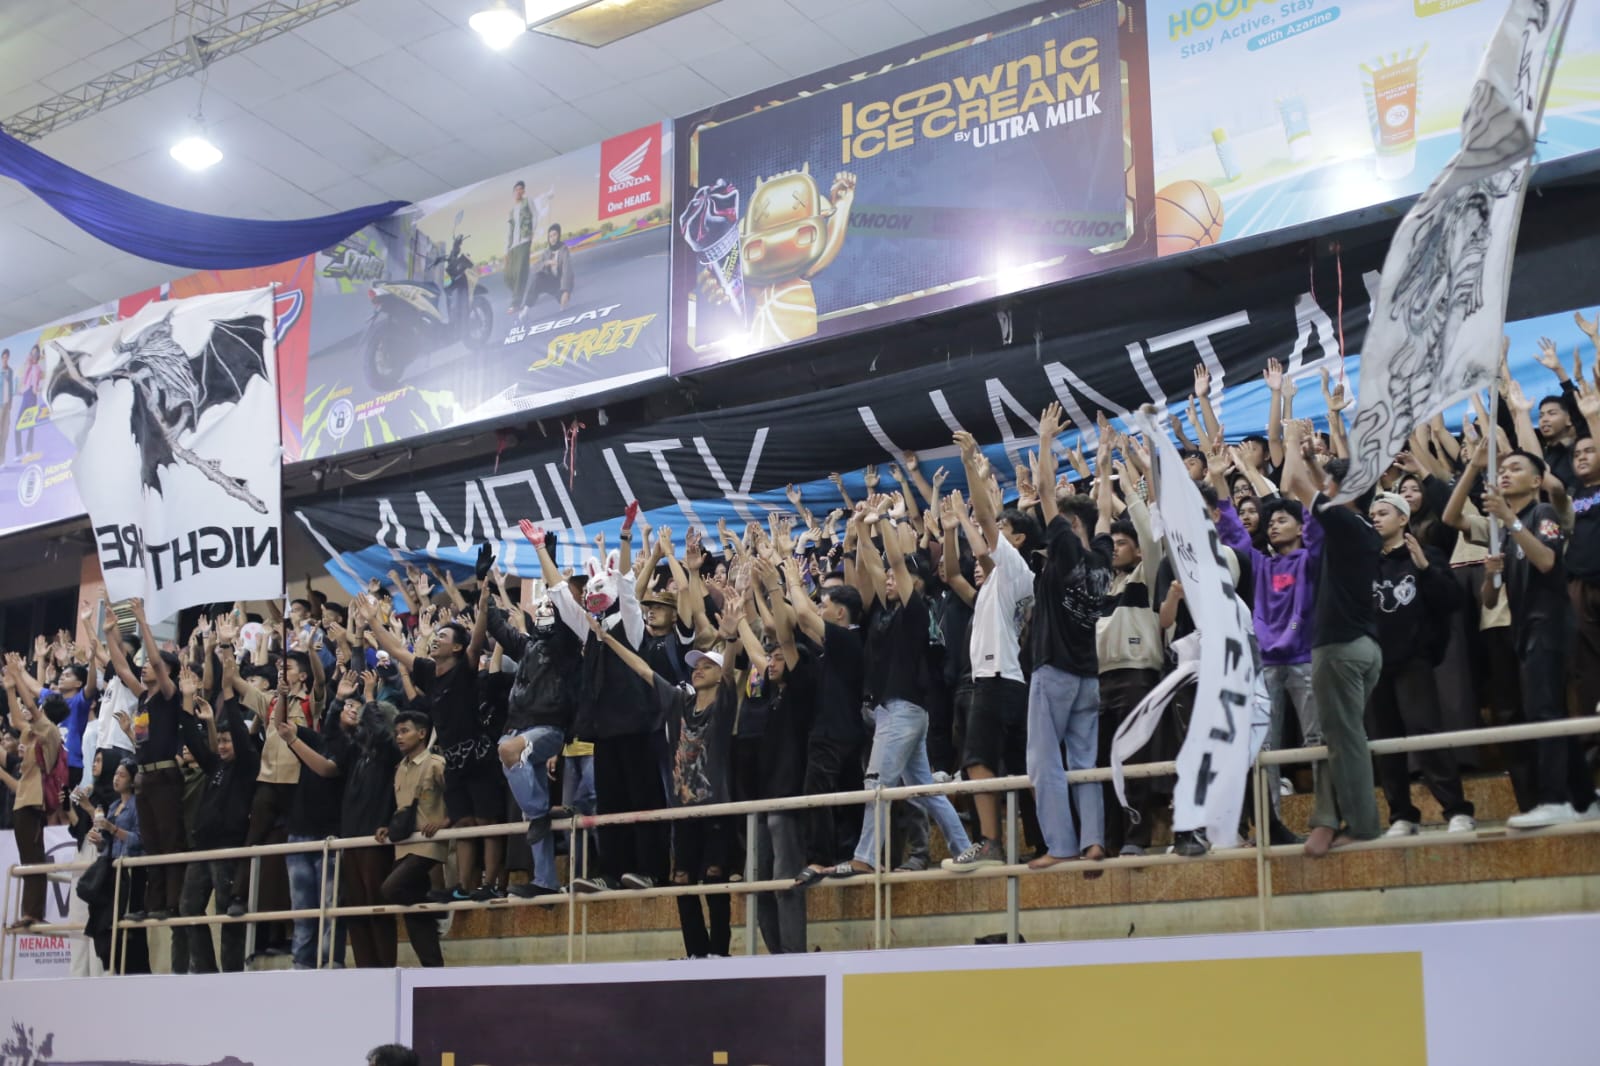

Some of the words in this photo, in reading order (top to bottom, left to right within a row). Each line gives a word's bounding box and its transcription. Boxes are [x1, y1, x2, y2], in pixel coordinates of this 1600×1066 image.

[1180, 37, 1215, 60] Stay
[1219, 14, 1276, 44] Active,
[1257, 30, 1284, 47] with
[1286, 11, 1332, 36] Azarine
[841, 118, 915, 165] ICE
[921, 62, 1100, 139] CREAM
[972, 111, 1040, 148] ULTRA
[1045, 92, 1102, 128] MILK
[608, 174, 652, 193] HONDA
[607, 201, 623, 213] One
[504, 333, 526, 345] NEW
[509, 325, 526, 337] ALL
[527, 313, 657, 372] STREET
[19, 934, 65, 951] MENARA
